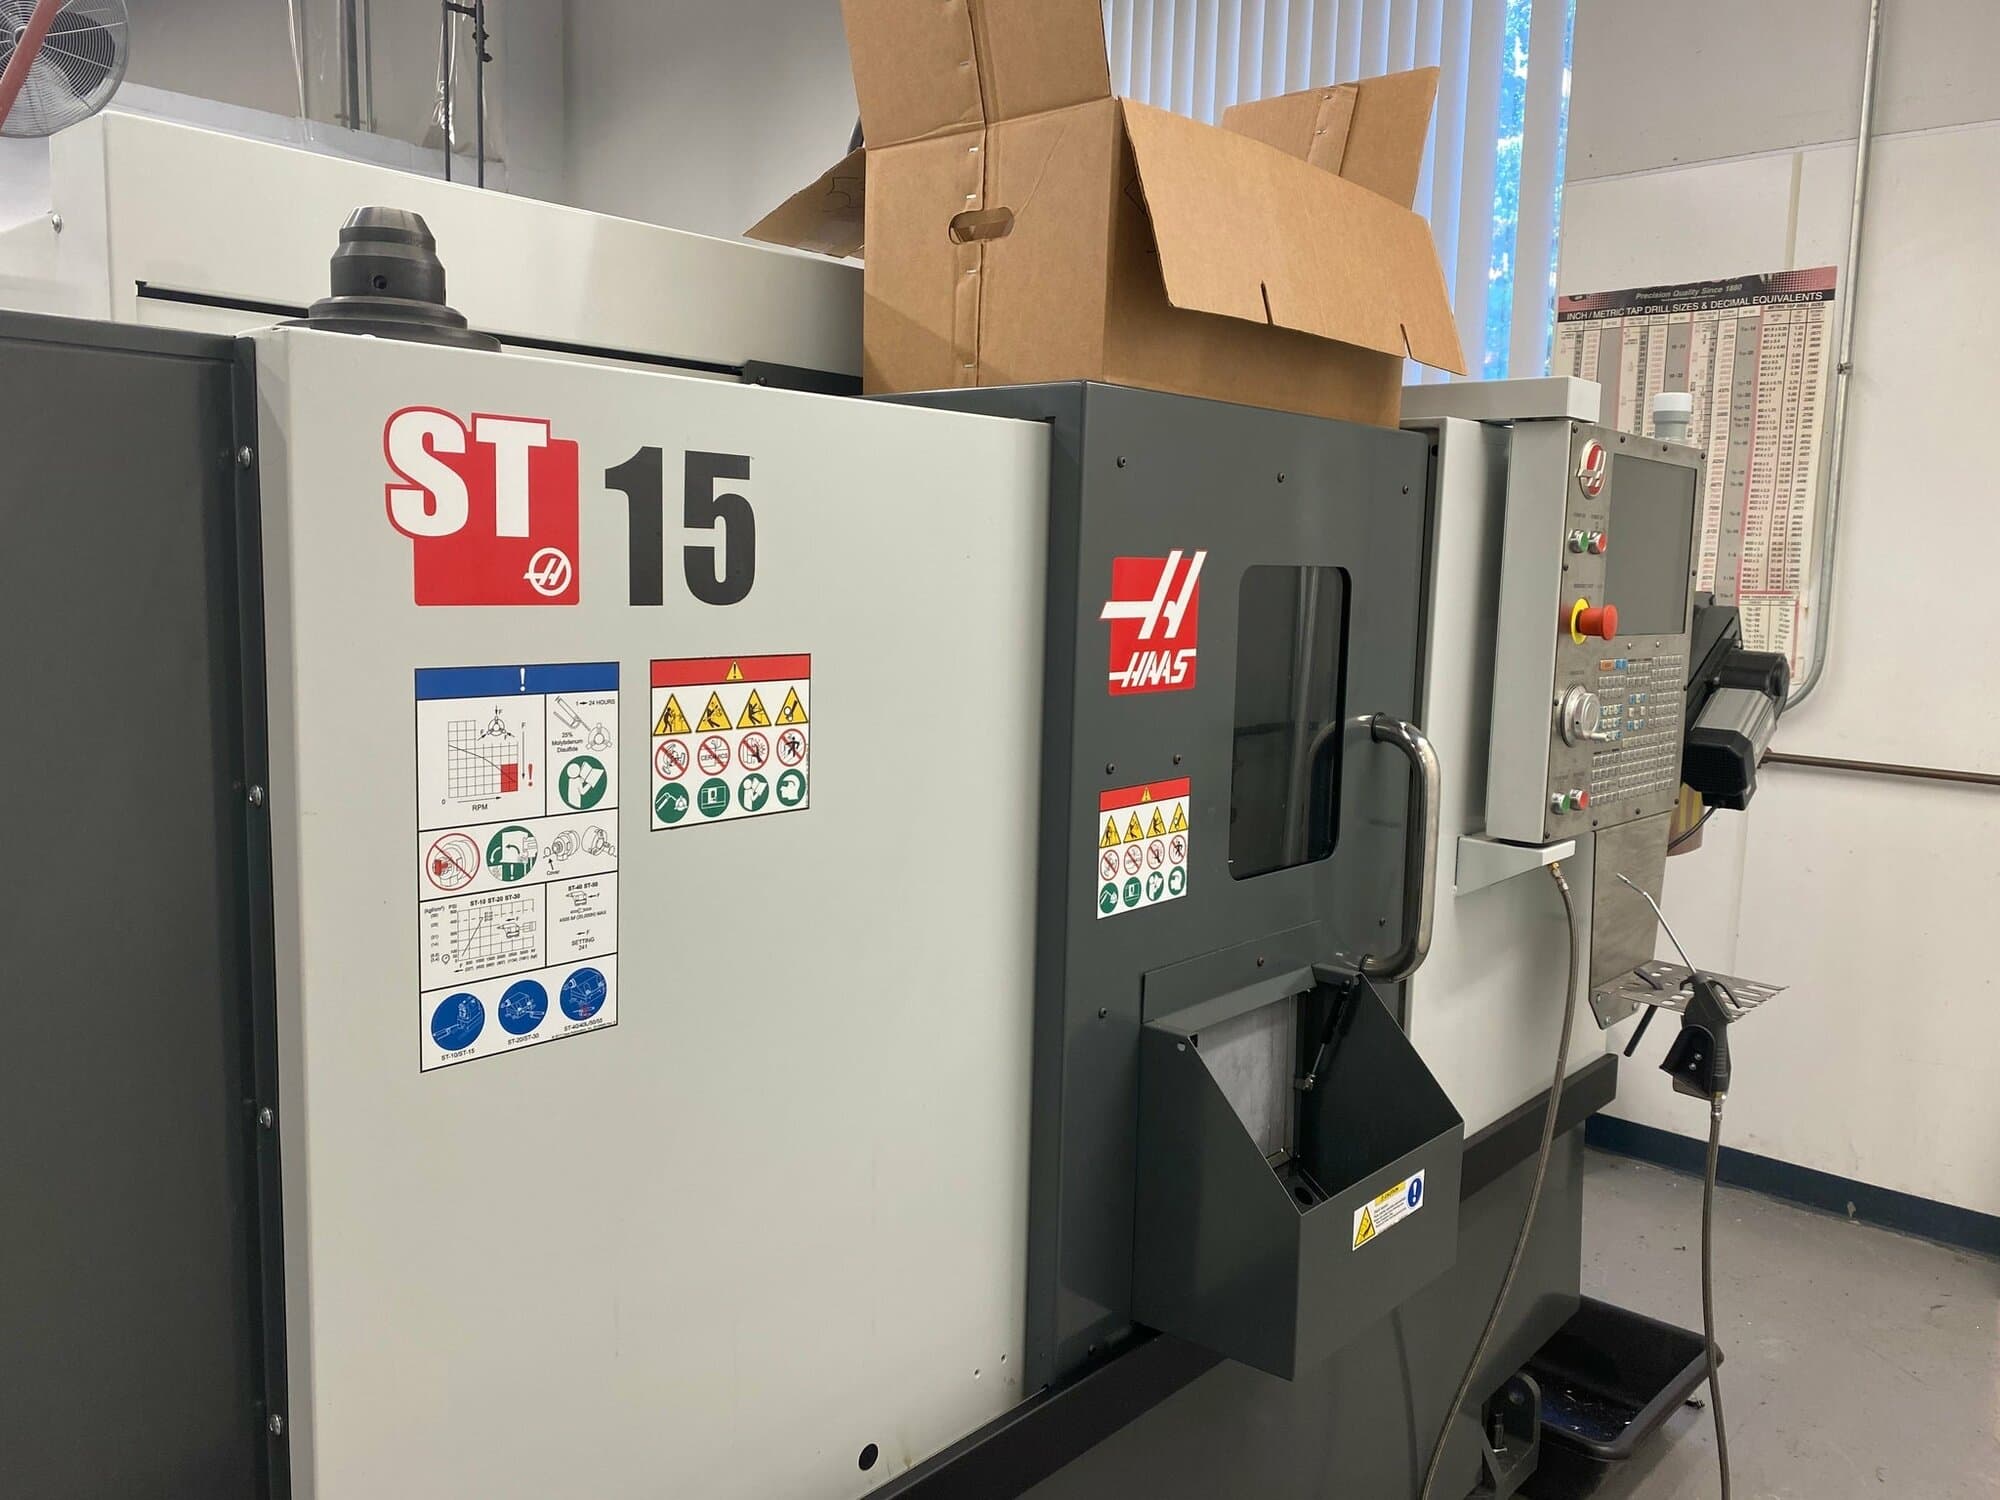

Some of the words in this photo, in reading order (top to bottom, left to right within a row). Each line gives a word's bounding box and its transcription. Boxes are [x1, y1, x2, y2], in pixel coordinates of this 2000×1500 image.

[1635, 291, 1671, 300] Precision
[1673, 288, 1699, 297] Quality
[1701, 286, 1723, 295] Since
[1626, 306, 1643, 315] TAP
[1644, 304, 1671, 314] DRILL
[1672, 302, 1699, 312] SIZES
[1701, 301, 1708, 310] &
[1710, 298, 1752, 309] DECIMAL
[1753, 292, 1823, 304] EQUIVALENTS
[387, 409, 549, 539] ST
[604, 446, 757, 606] 15
[1109, 648, 1197, 687] HAAS
[571, 937, 595, 946] SETTING
[507, 1032, 540, 1046] ST-20/ST-30
[441, 1048, 475, 1062] ST-10/ST-15
